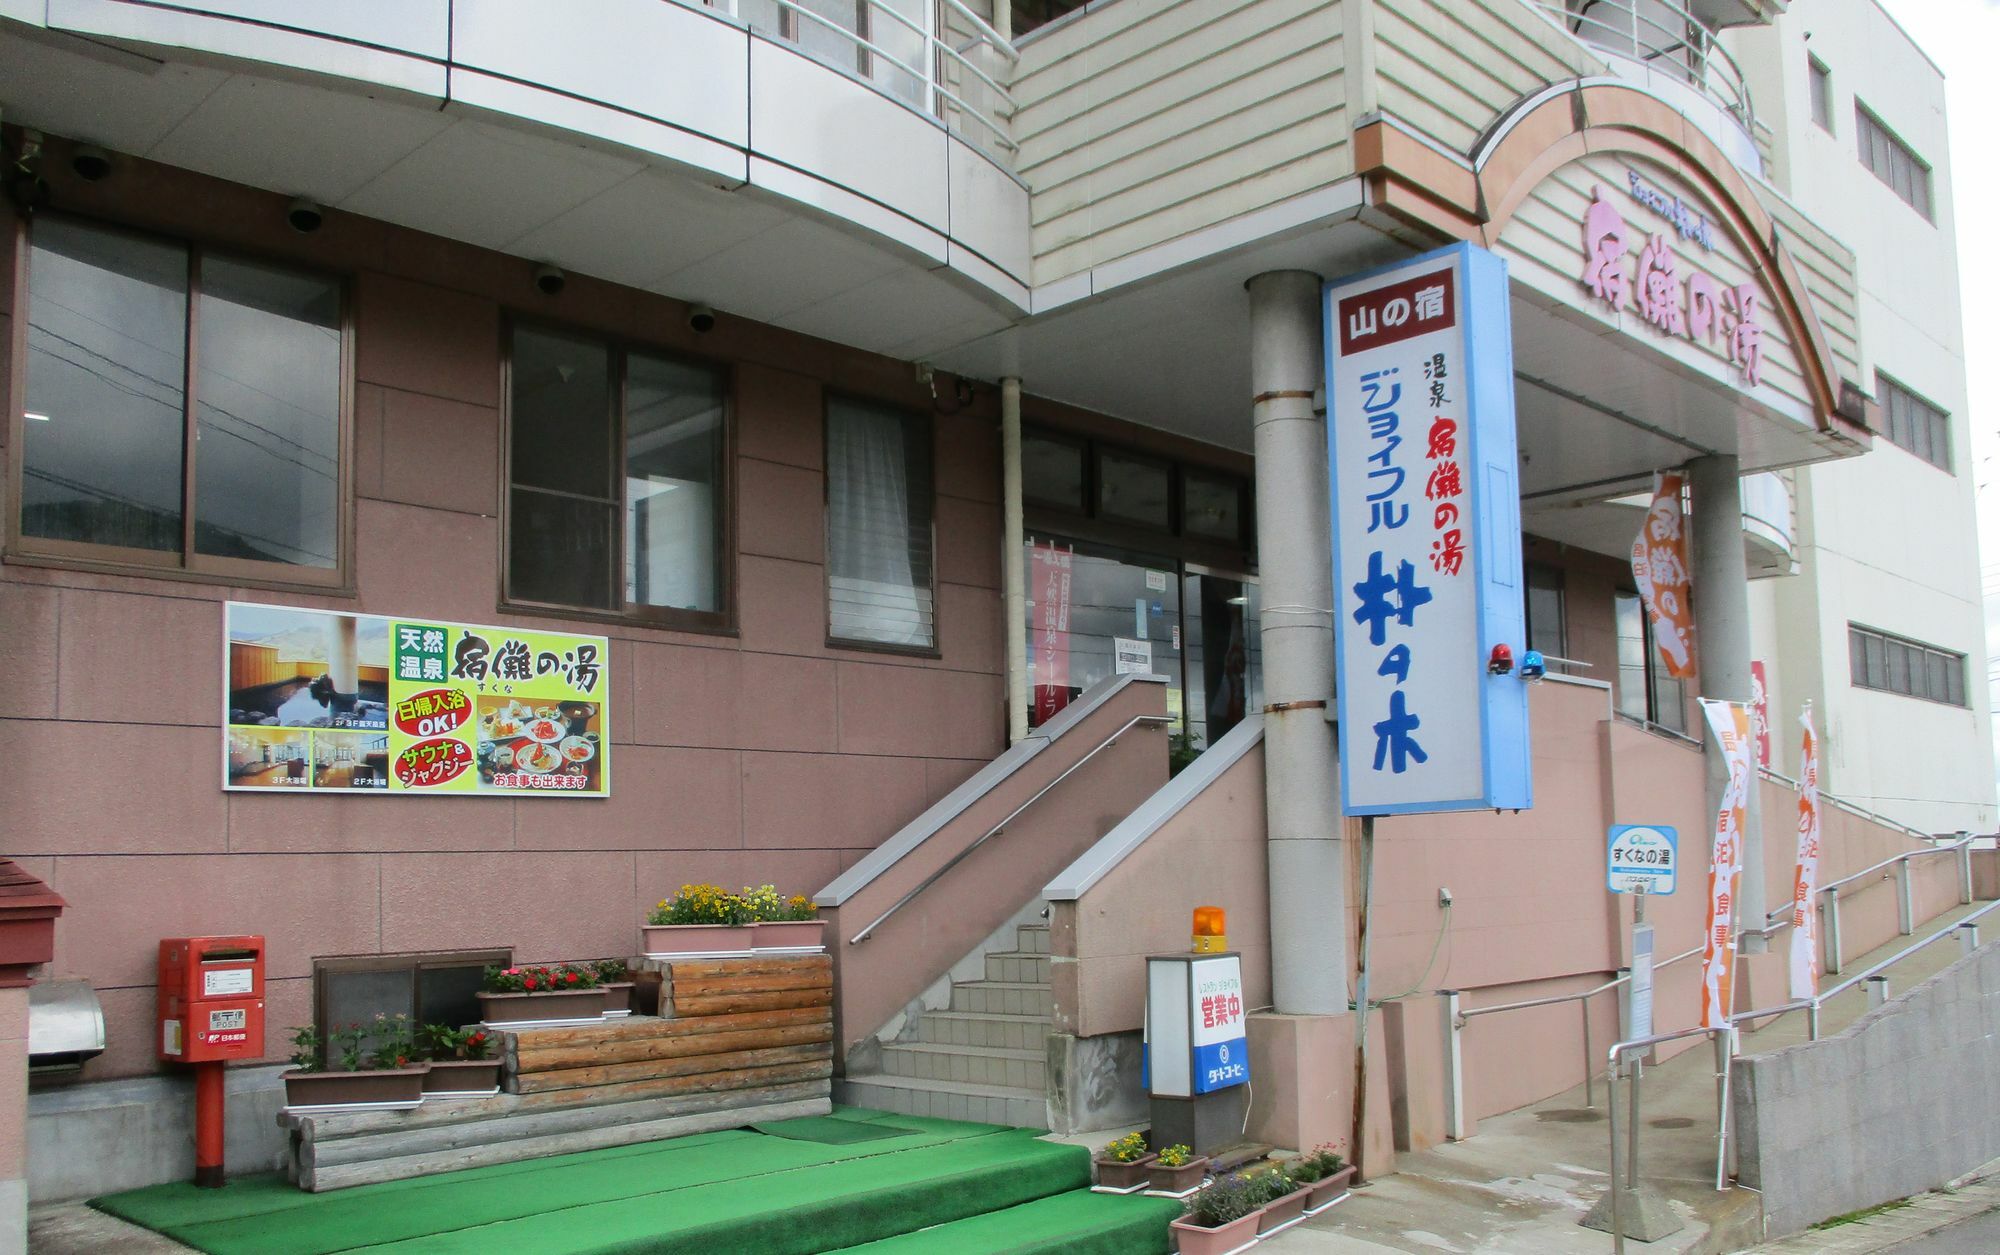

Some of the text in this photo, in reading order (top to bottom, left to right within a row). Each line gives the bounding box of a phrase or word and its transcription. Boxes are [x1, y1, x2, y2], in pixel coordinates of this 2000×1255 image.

[1349, 284, 1446, 341] 山の宿
[1423, 352, 1452, 407] 温泉
[1352, 367, 1434, 775] ジョイフル 朴の木
[400, 628, 445, 654] 天然
[400, 655, 444, 681] 温泉
[477, 683, 513, 694] すくな
[397, 688, 466, 722] 日帰入浴
[418, 712, 458, 736] OK!
[401, 757, 475, 788] ジャグジー
[493, 774, 588, 789] お食事も出来ます
[1613, 847, 1671, 865] すくなの湯
[1201, 992, 1241, 1029] 営業中
[215, 1020, 239, 1028] POST
